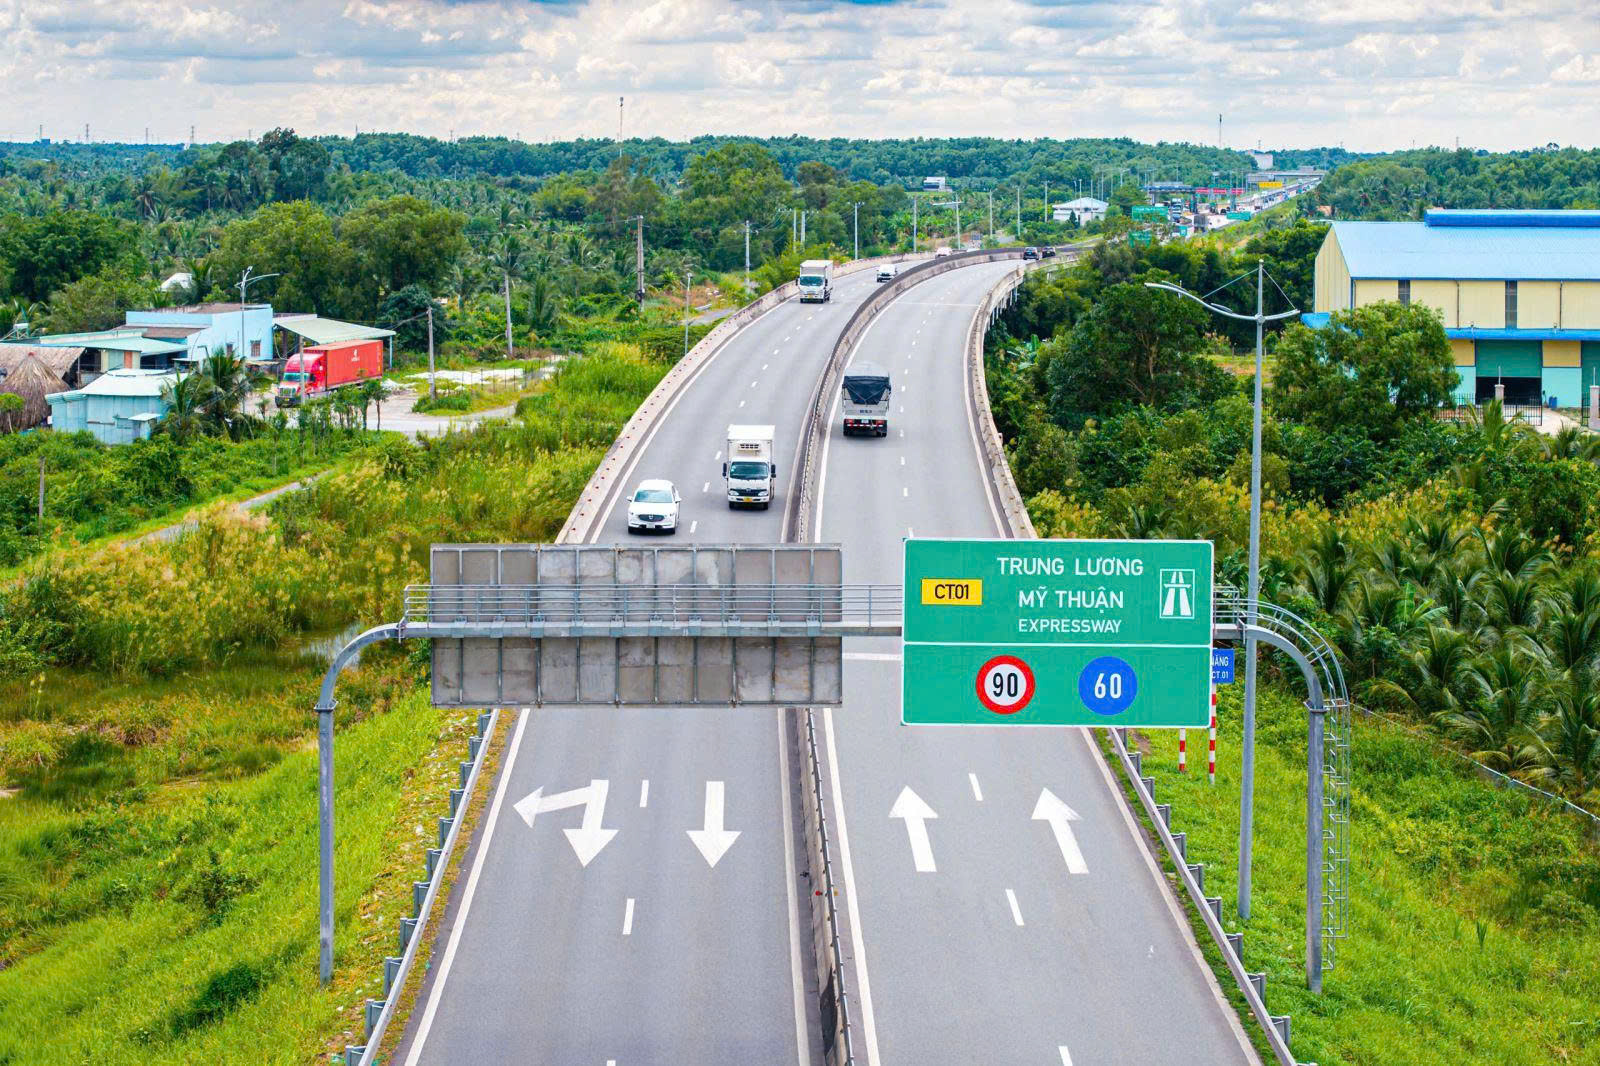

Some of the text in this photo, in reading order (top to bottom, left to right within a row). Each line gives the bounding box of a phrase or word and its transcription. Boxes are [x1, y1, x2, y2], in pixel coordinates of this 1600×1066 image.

[997, 557, 1144, 576] TRUNG LƯƠNG
[1019, 586, 1124, 614] MỸ THUẬN
[1018, 619, 1122, 634] EXPRESSWAY
[992, 672, 1019, 698] 90
[1094, 673, 1122, 699] 60
